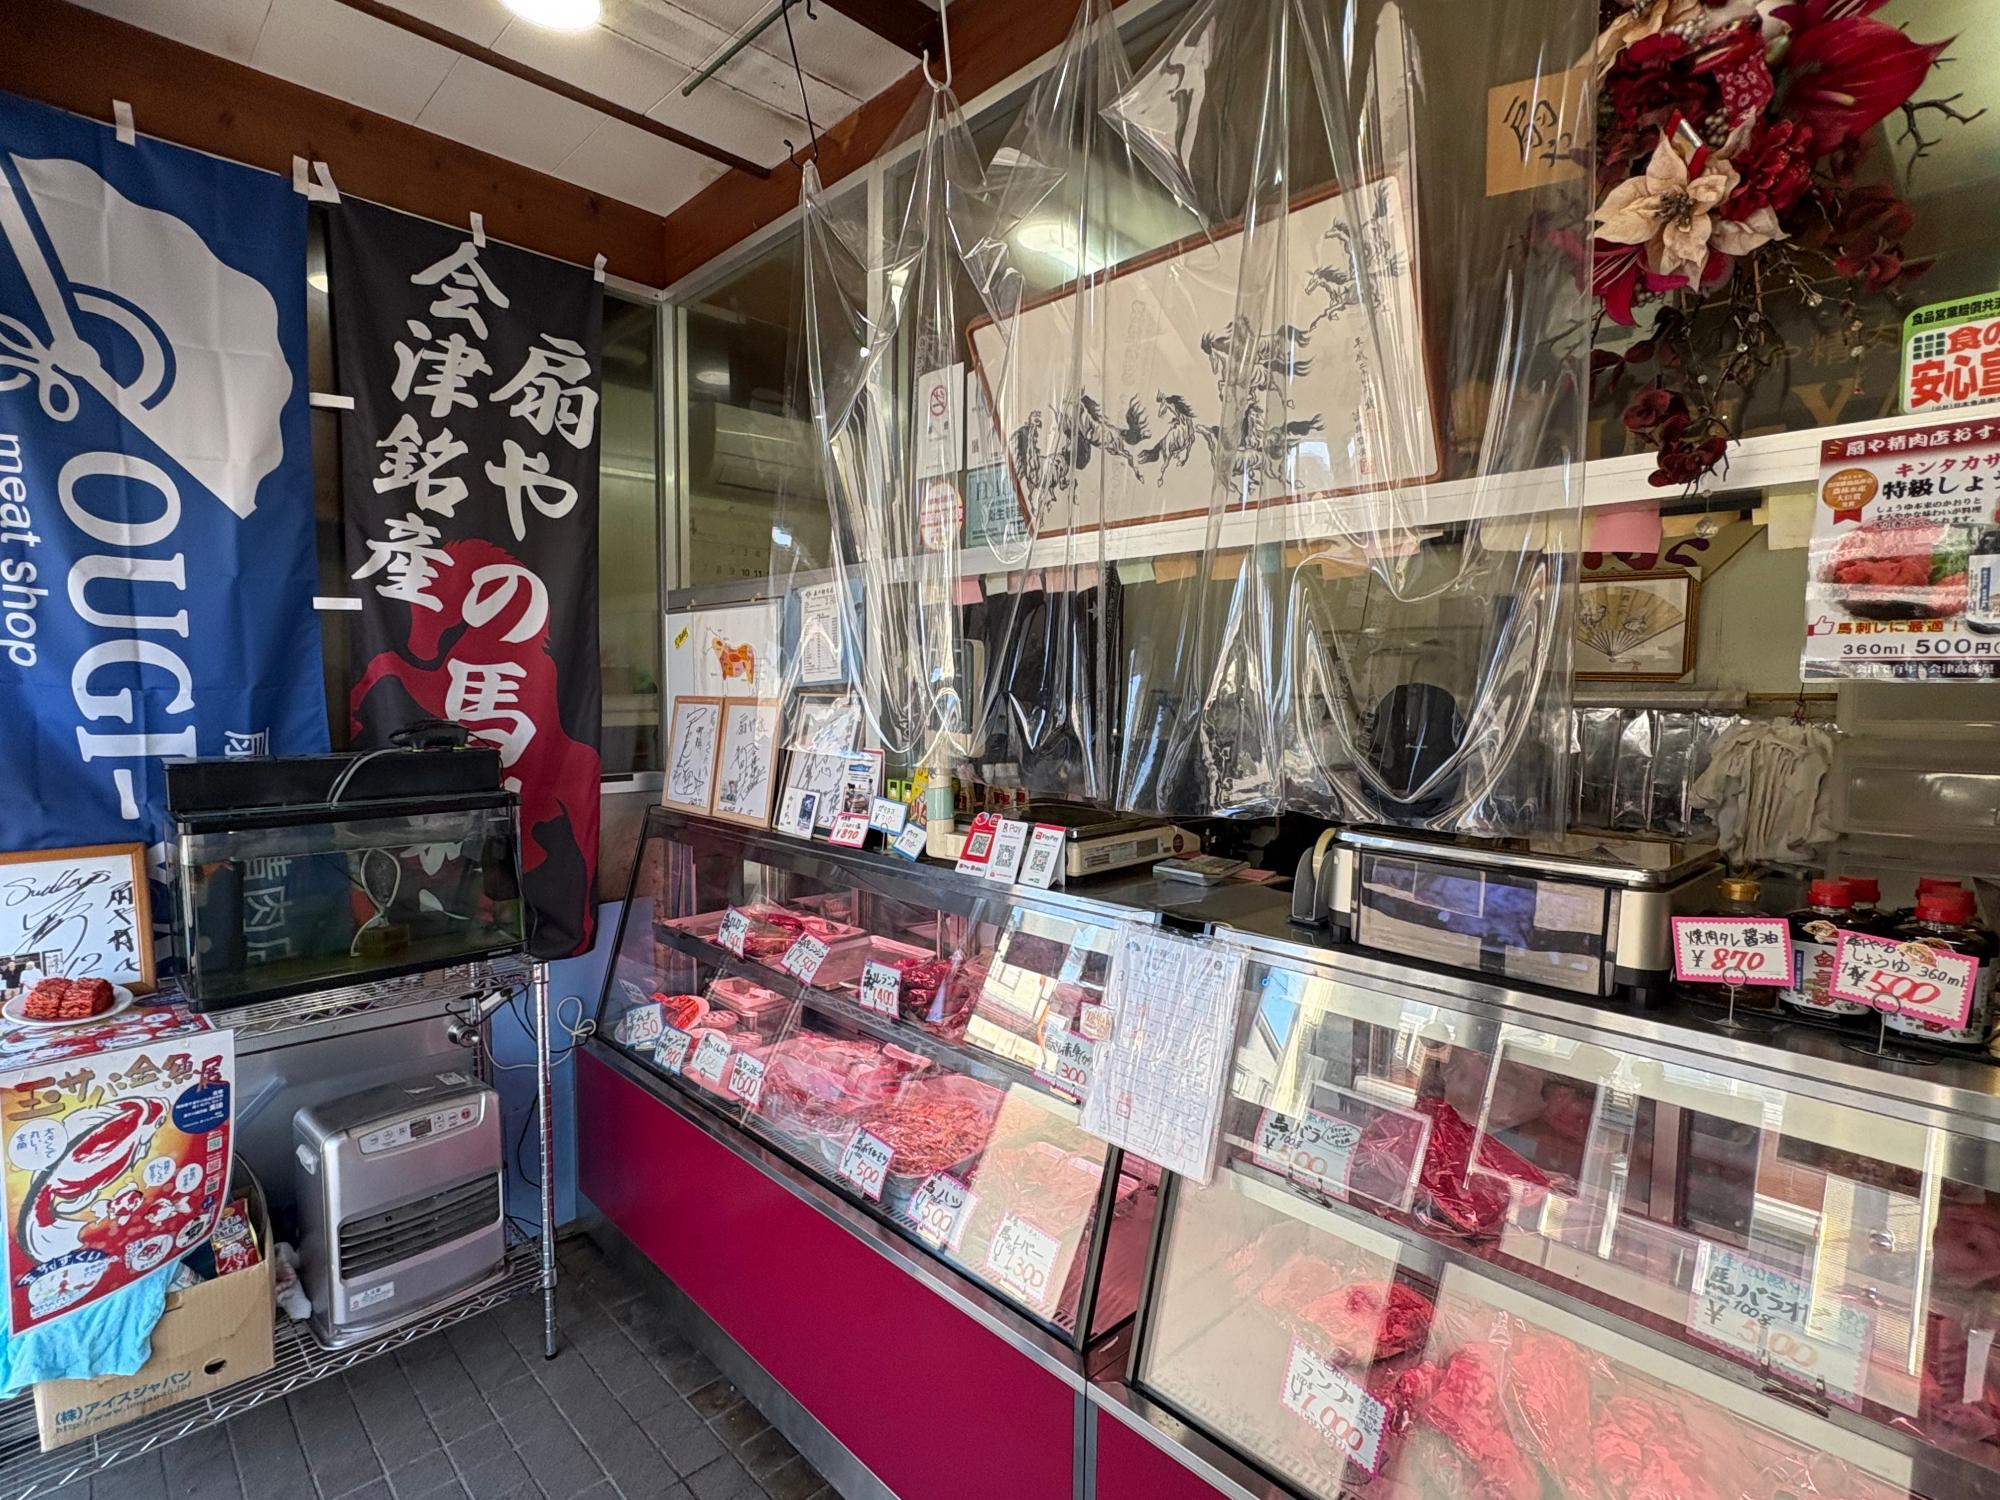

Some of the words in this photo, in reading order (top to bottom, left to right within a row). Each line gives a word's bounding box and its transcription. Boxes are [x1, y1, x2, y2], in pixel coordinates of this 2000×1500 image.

[351, 241, 510, 612] 会津銘産
[1846, 425, 2000, 457] 扇や精肉店おす
[0, 433, 42, 548] meat
[0, 558, 49, 668] shop
[1843, 644, 1905, 655] 360ml
[1852, 948, 1911, 974] しょうゆ
[1915, 966, 1967, 989] 360ml
[1300, 1357, 1355, 1405] ランプ
